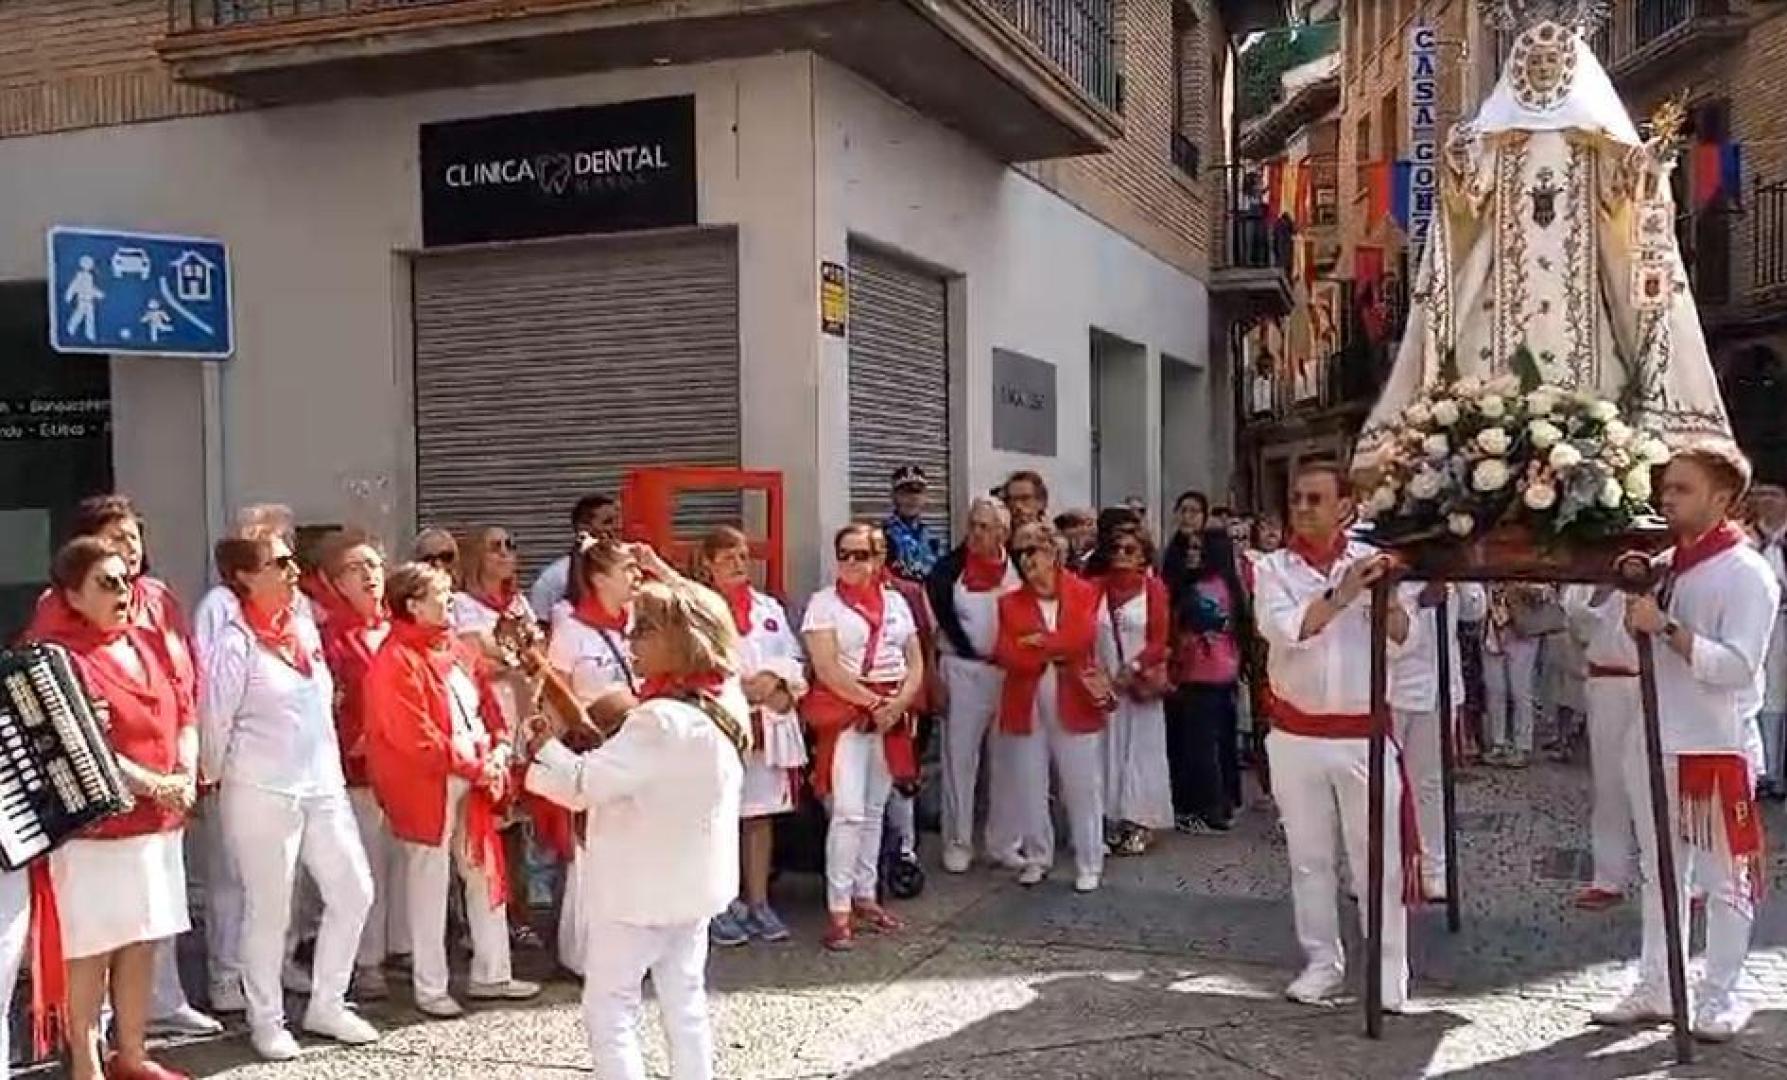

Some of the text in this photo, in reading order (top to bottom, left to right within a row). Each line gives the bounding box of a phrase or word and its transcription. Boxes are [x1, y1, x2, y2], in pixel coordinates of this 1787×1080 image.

[1415, 30, 1434, 125] CASA
[445, 144, 669, 188] CLINICA DENTAL
